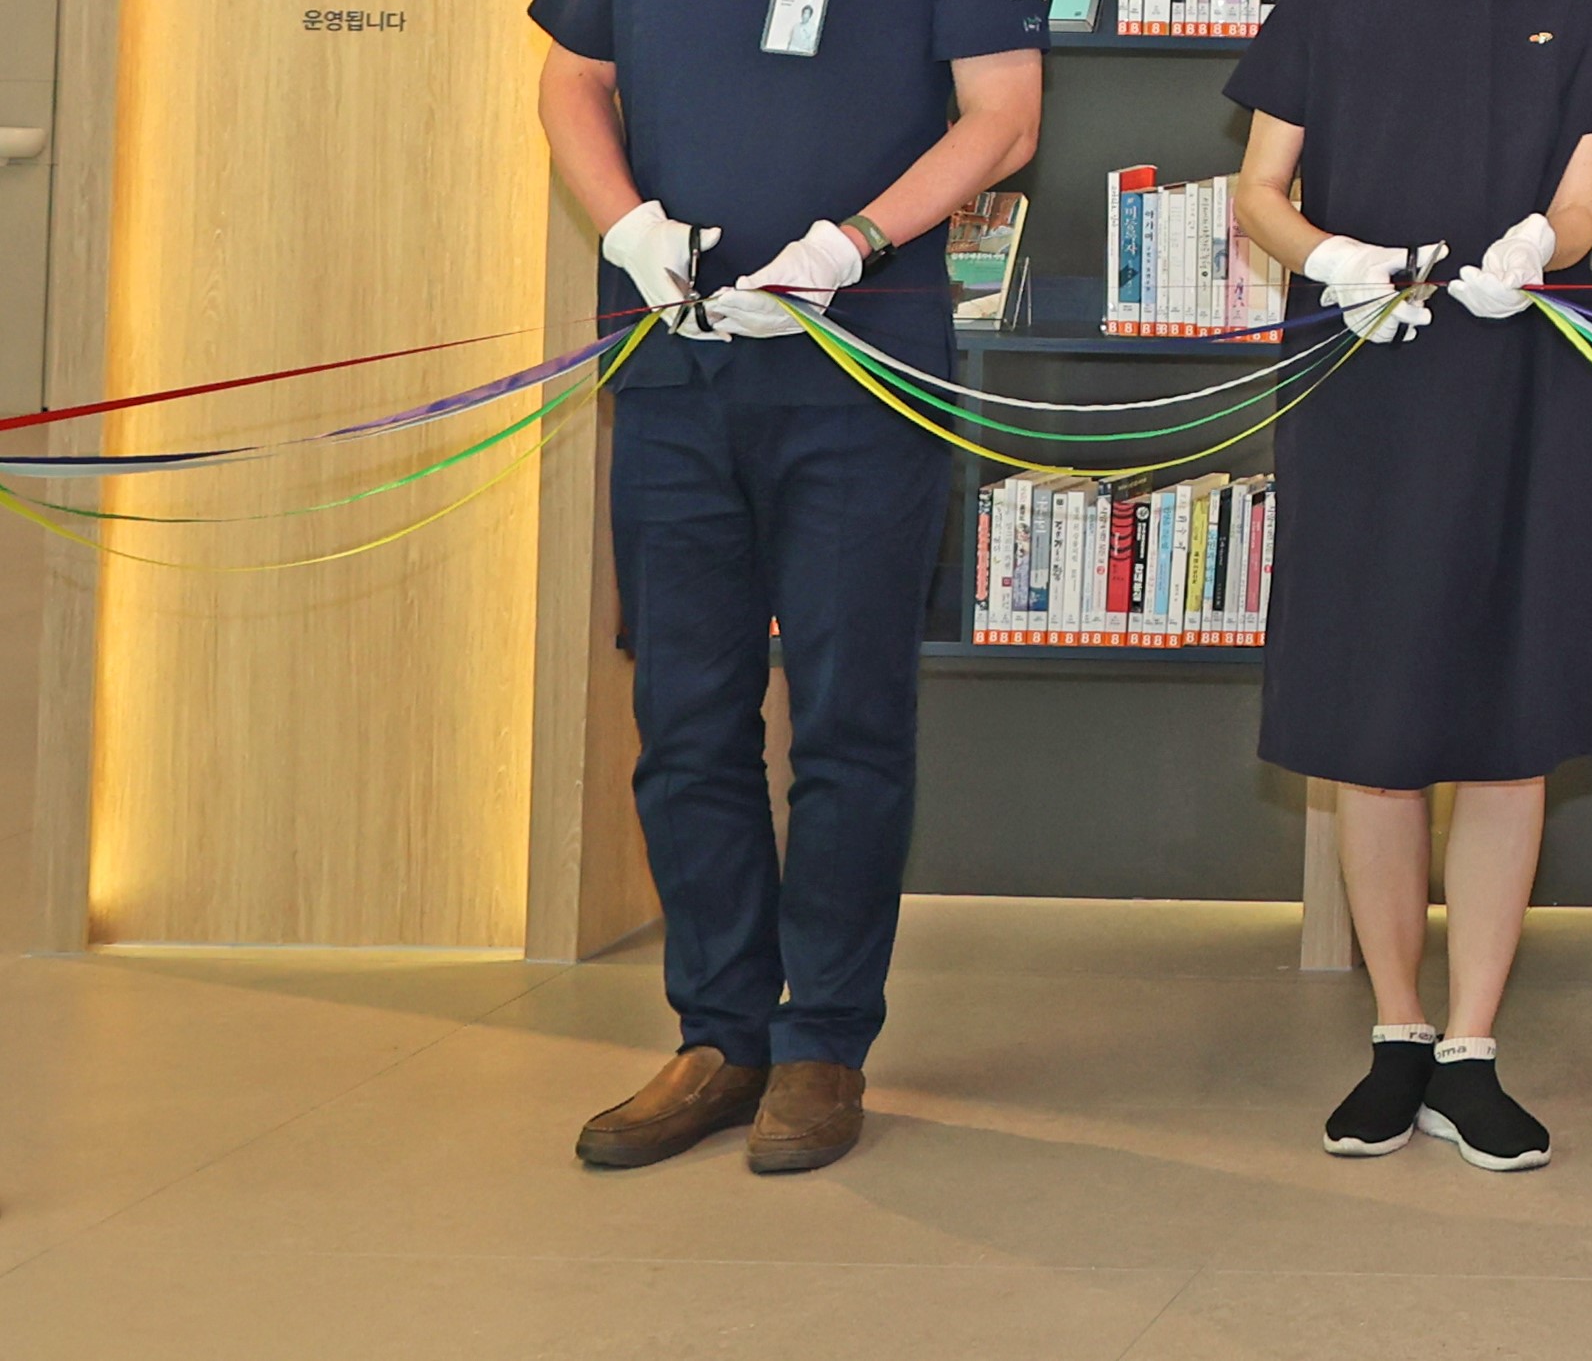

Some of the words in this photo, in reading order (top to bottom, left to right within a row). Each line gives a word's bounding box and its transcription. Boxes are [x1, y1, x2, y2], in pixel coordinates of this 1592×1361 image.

[302, 10, 406, 32] 운영됩니다
[1151, 22, 1161, 36] 8
[1198, 22, 1208, 36] 8
[974, 630, 985, 643] 8
[1065, 632, 1074, 644] 8
